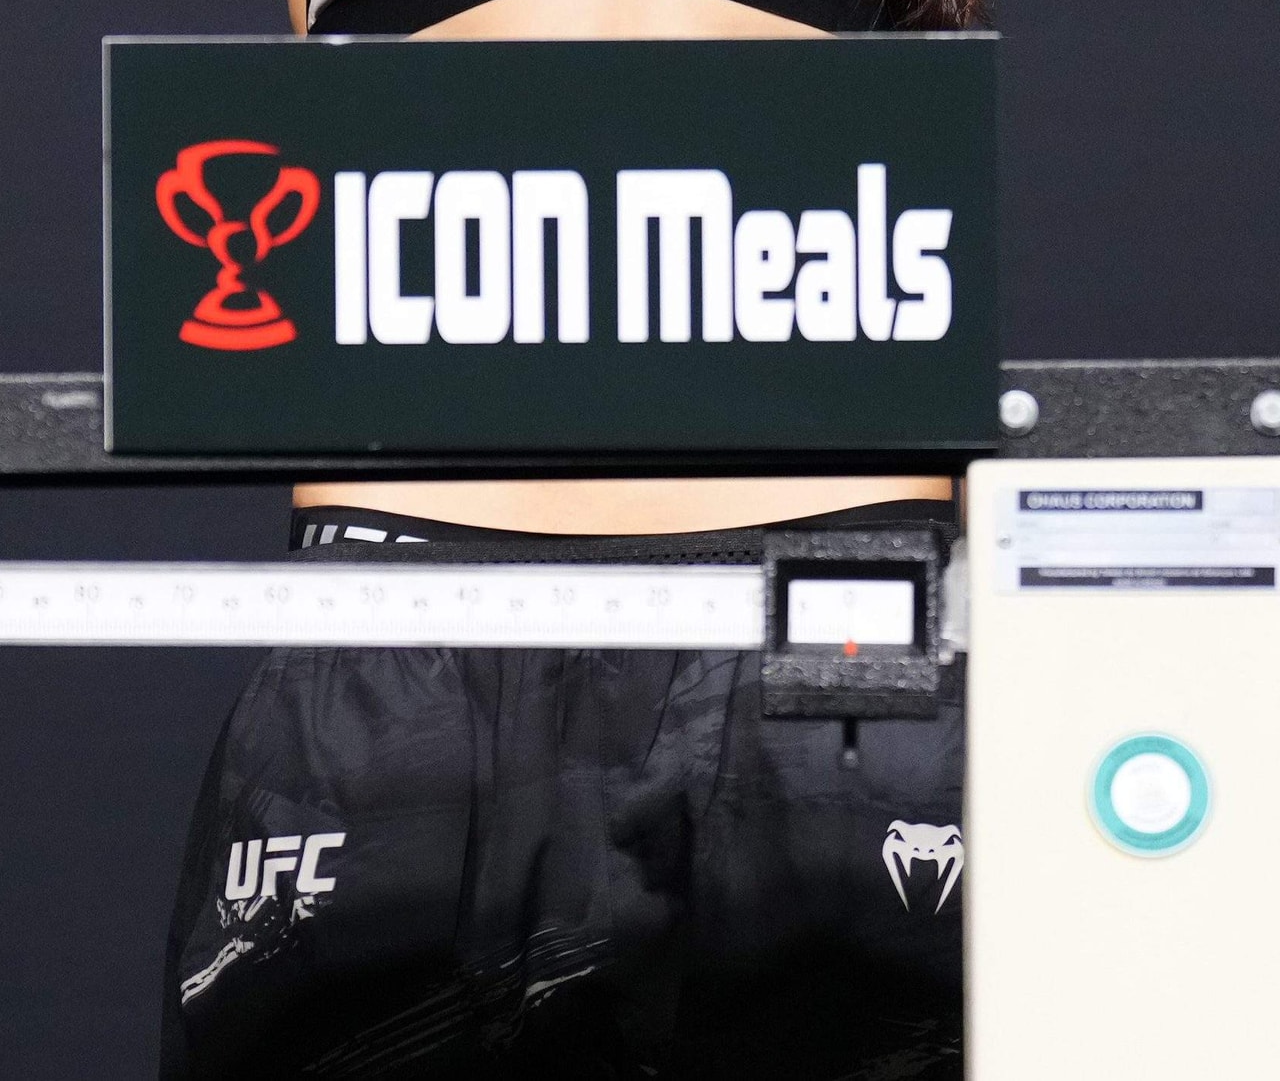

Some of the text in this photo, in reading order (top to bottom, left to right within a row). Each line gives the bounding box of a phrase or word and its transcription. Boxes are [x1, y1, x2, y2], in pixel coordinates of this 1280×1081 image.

[334, 162, 953, 345] ICON Meals
[224, 832, 347, 901] UFC
